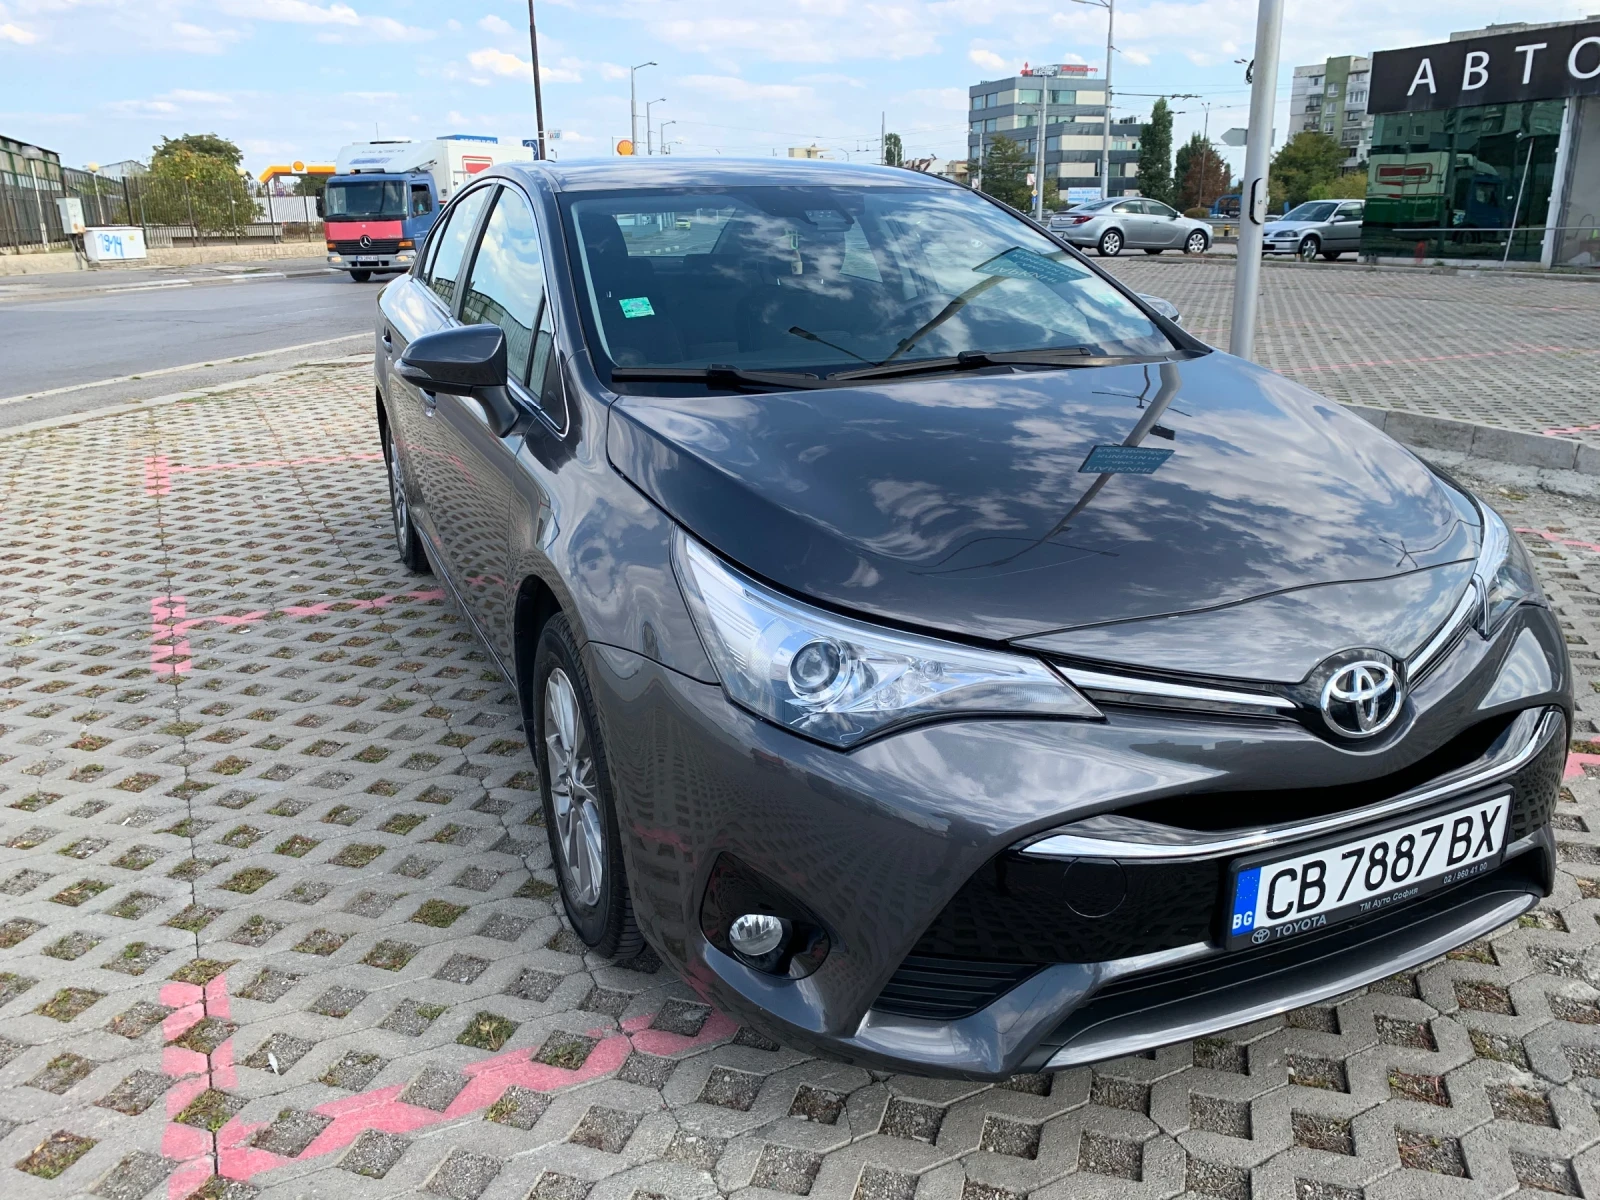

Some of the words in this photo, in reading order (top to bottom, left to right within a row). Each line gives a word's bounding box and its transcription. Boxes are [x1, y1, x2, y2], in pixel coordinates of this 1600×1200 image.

[1407, 36, 1600, 96] АВТО
[1266, 859, 1327, 920] CB
[1336, 823, 1444, 902] 7887
[1446, 804, 1502, 867] BX
[1443, 875, 1452, 884] 02
[1479, 861, 1488, 871] 00
[1372, 896, 1390, 908] Ауто
[1392, 887, 1419, 901] София
[1232, 910, 1253, 930] BG
[1275, 914, 1327, 938] TOYOTA
